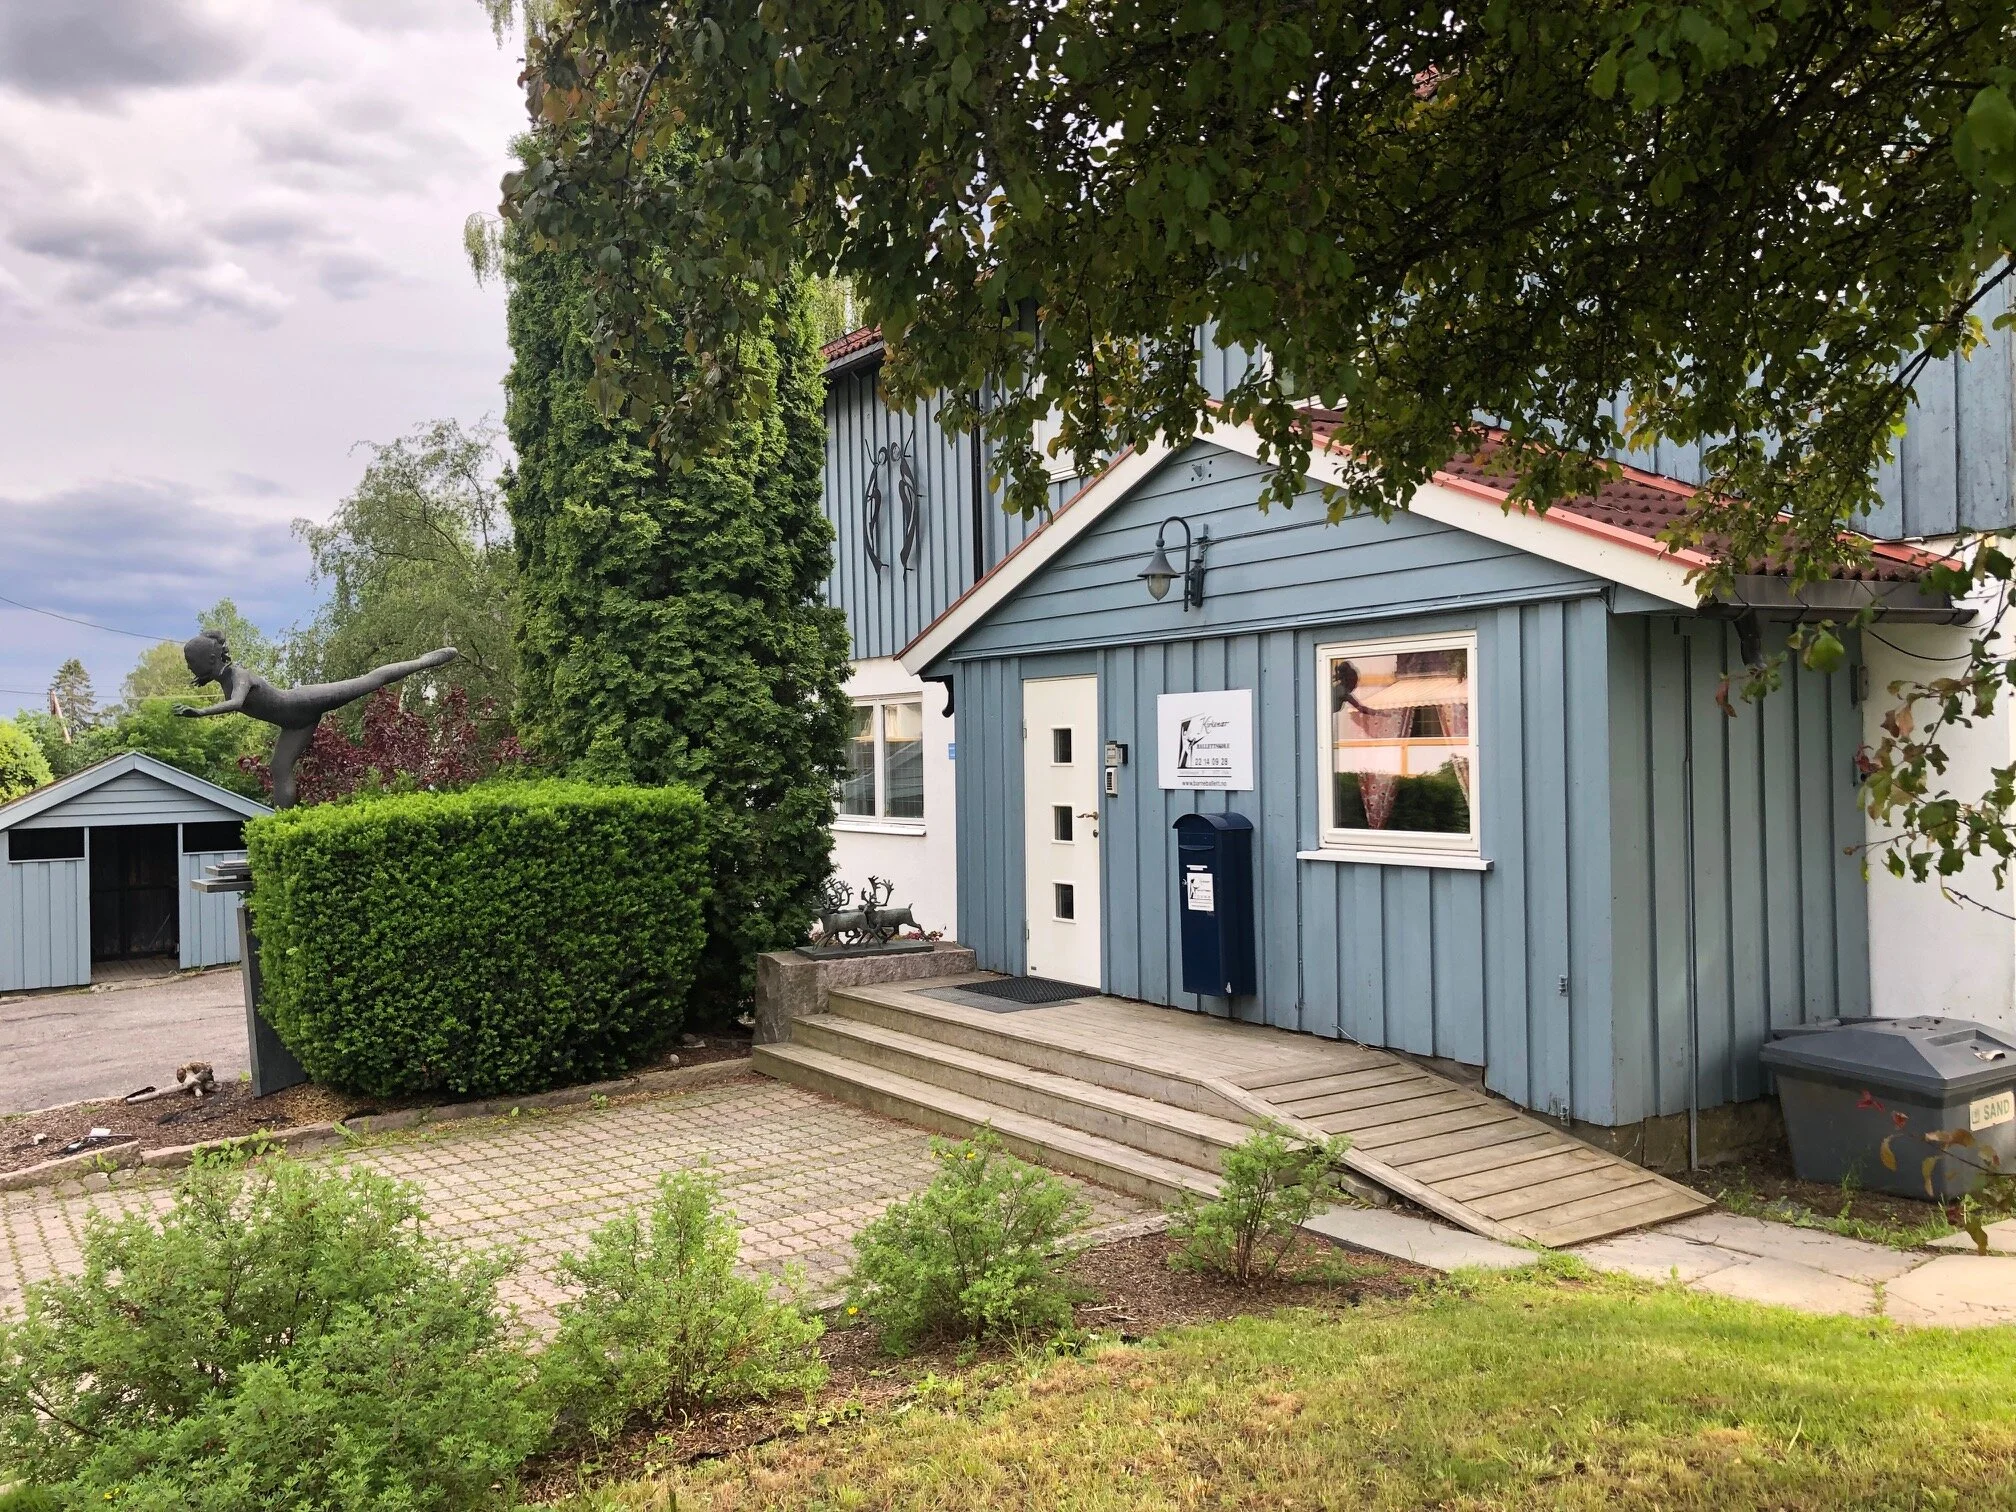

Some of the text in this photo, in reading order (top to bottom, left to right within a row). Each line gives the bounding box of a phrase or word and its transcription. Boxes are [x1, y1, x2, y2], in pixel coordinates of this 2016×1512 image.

[1195, 758, 1202, 766] 22
[1204, 758, 1210, 766] 14
[1984, 1099, 2010, 1120] SAND
